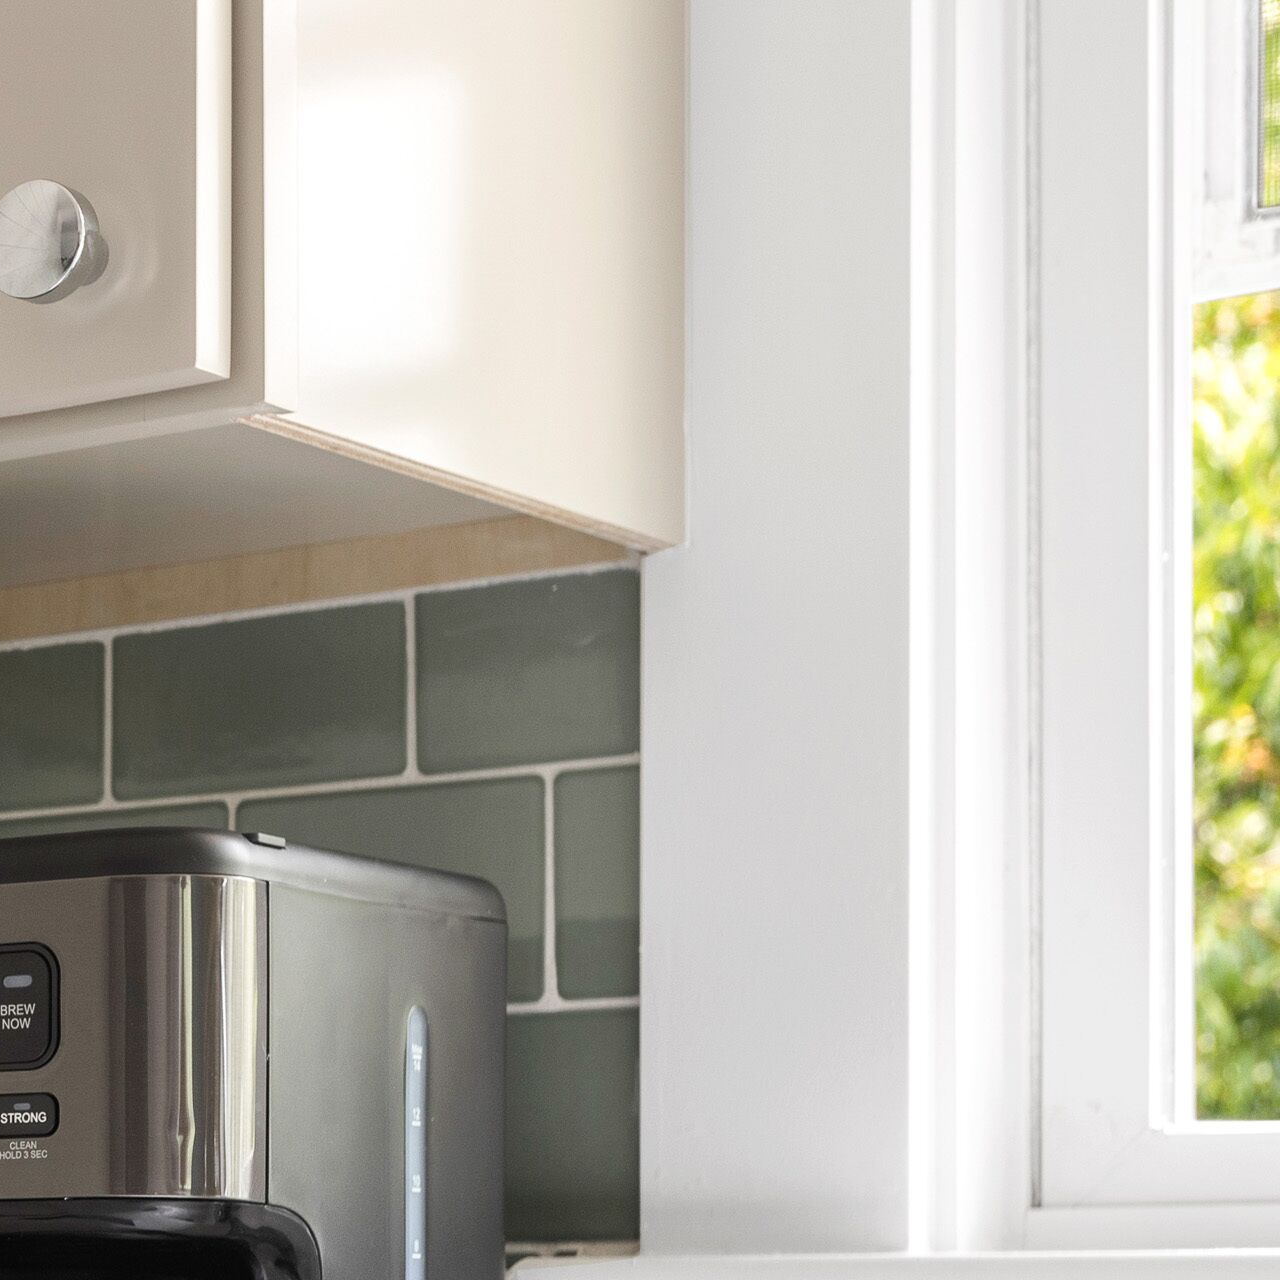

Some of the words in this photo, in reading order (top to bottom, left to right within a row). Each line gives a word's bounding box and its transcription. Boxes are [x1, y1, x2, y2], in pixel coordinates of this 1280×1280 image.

[1, 1003, 35, 1016] BREW
[2, 1018, 31, 1030] NOW
[0, 1112, 47, 1124] STRONG
[9, 1140, 37, 1150] CLEAN
[0, 1151, 22, 1160] HOLD
[24, 1151, 29, 1159] 3
[30, 1150, 48, 1159] SEC
